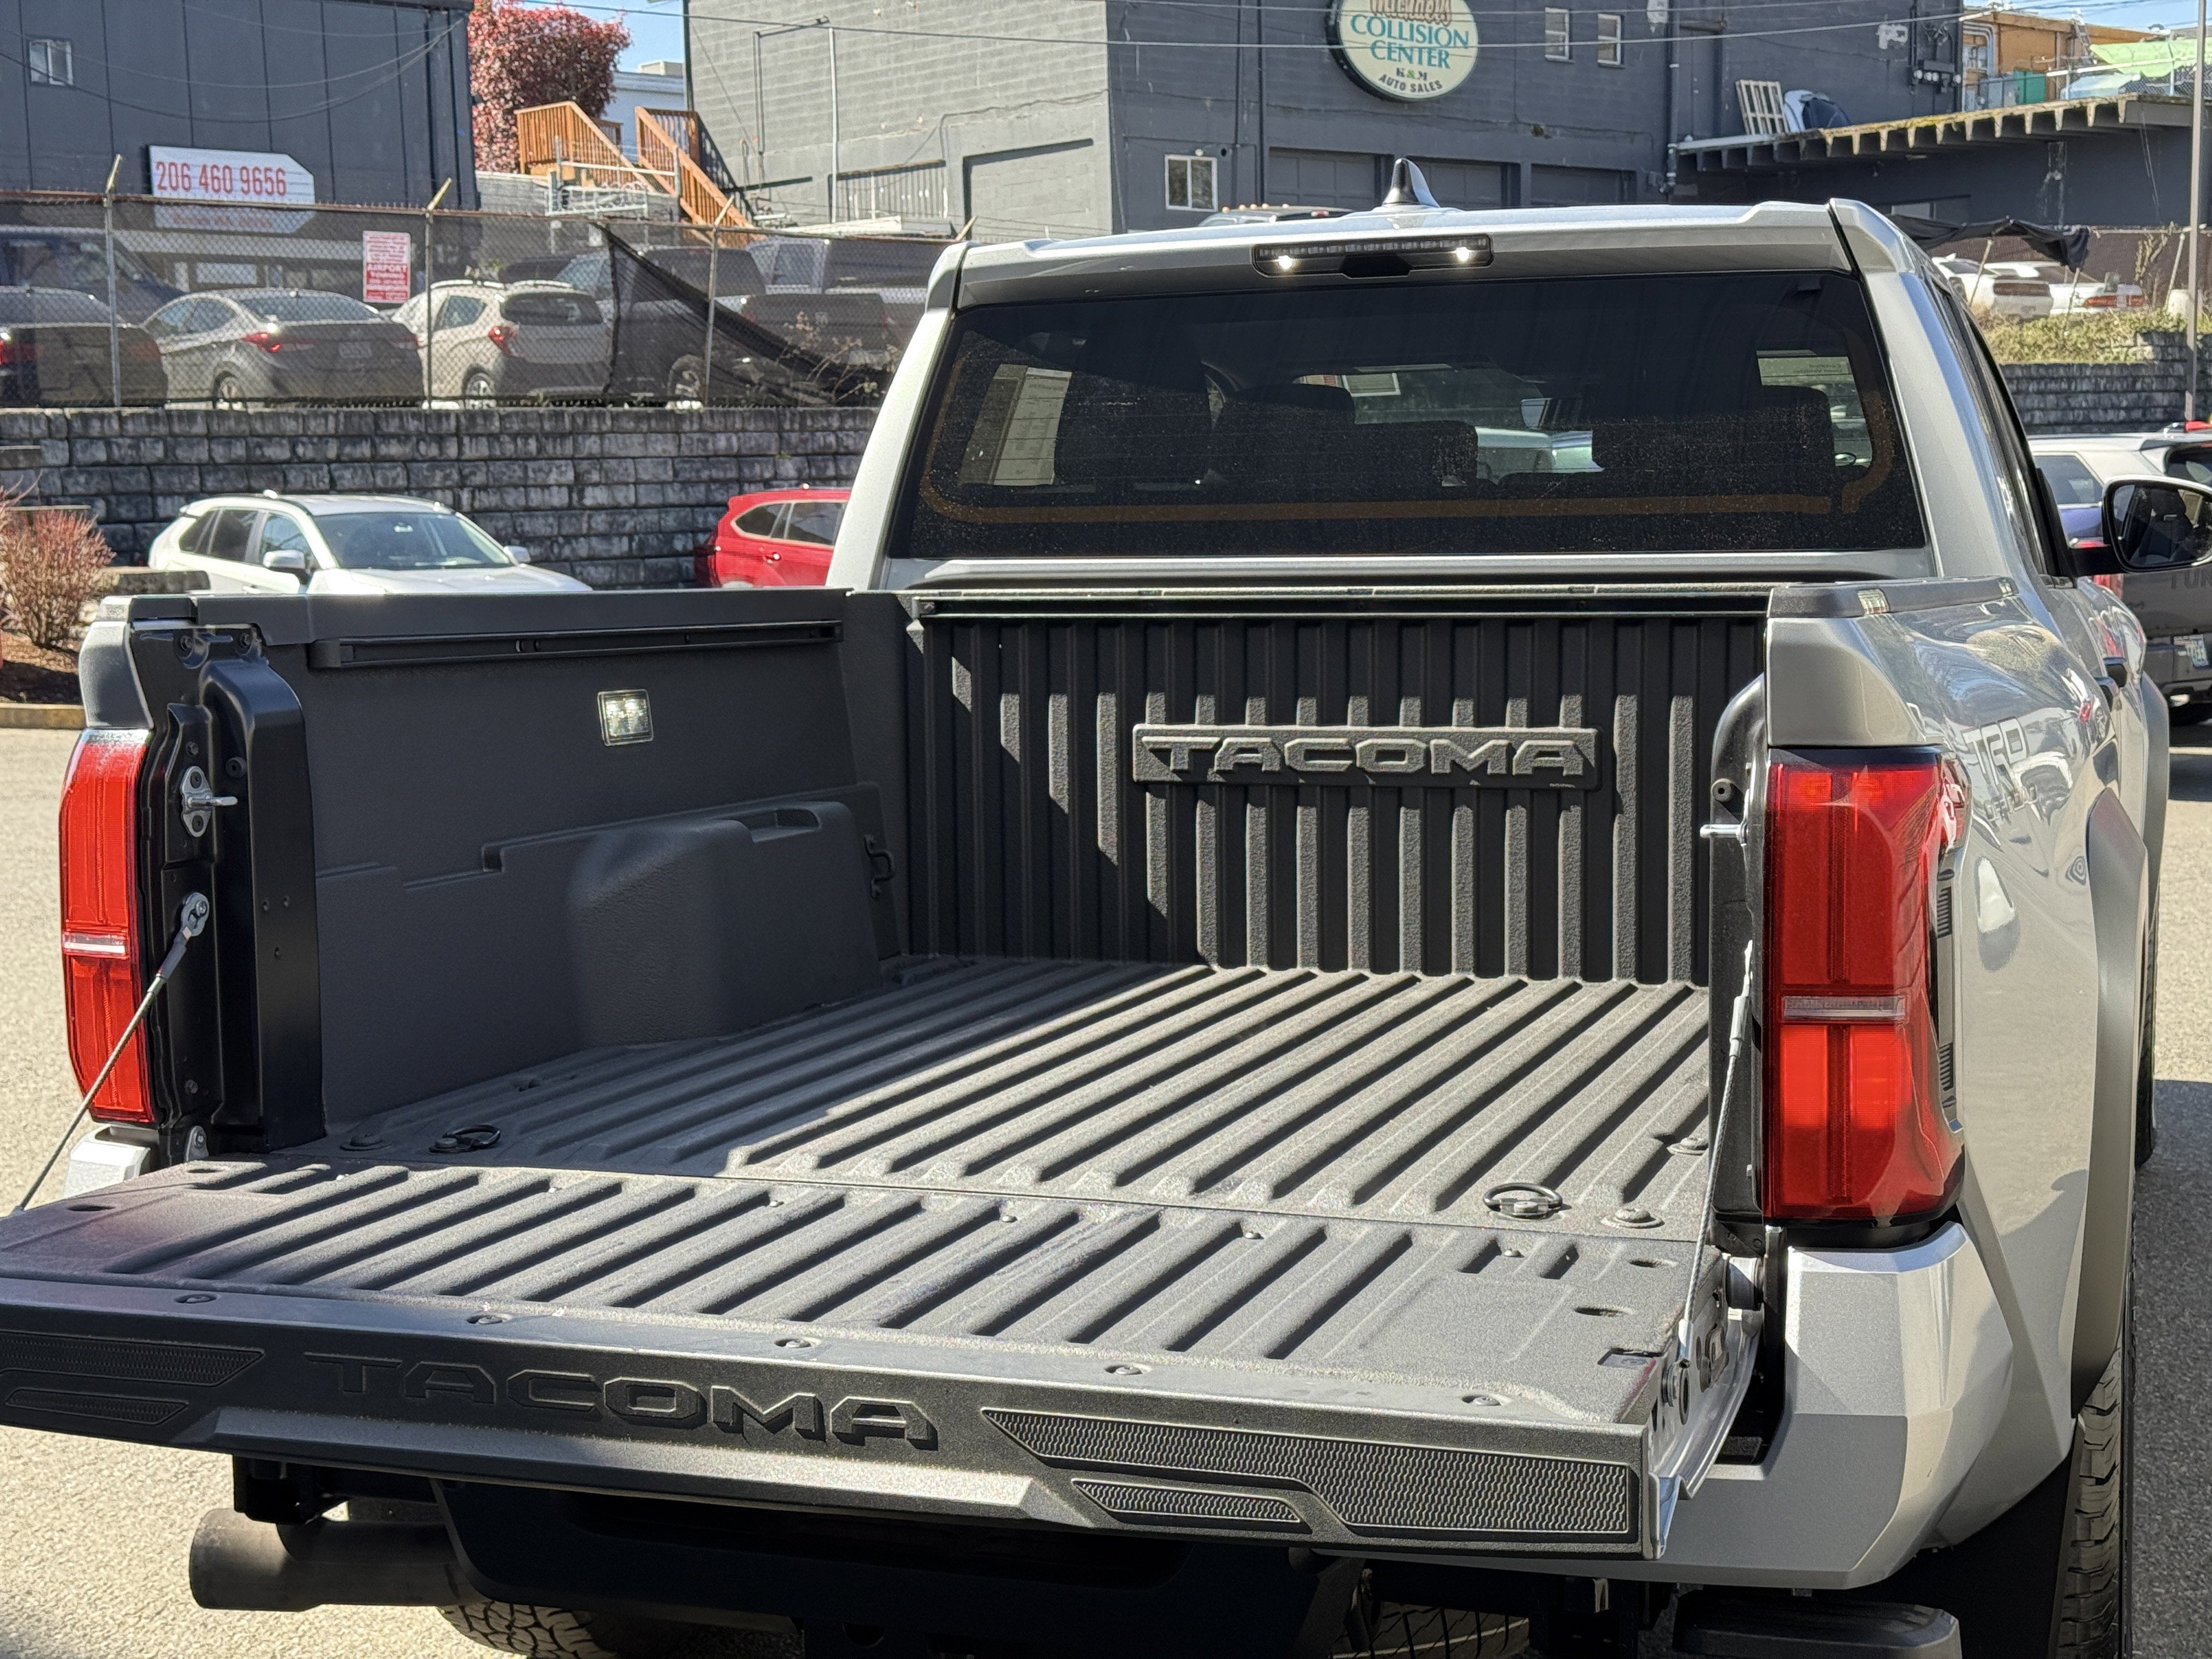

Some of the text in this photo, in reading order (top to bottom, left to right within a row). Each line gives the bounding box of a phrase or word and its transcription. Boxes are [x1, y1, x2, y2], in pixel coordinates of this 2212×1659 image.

[1350, 13, 1469, 49] COLLISION
[1370, 39, 1451, 69] CENTER
[1379, 74, 1443, 93] AUTO SALES
[155, 161, 287, 196] 206 460 9656
[1141, 736, 1584, 778] TACOMA
[1961, 716, 2029, 788] TRD
[303, 1351, 939, 1451] TACOMA
